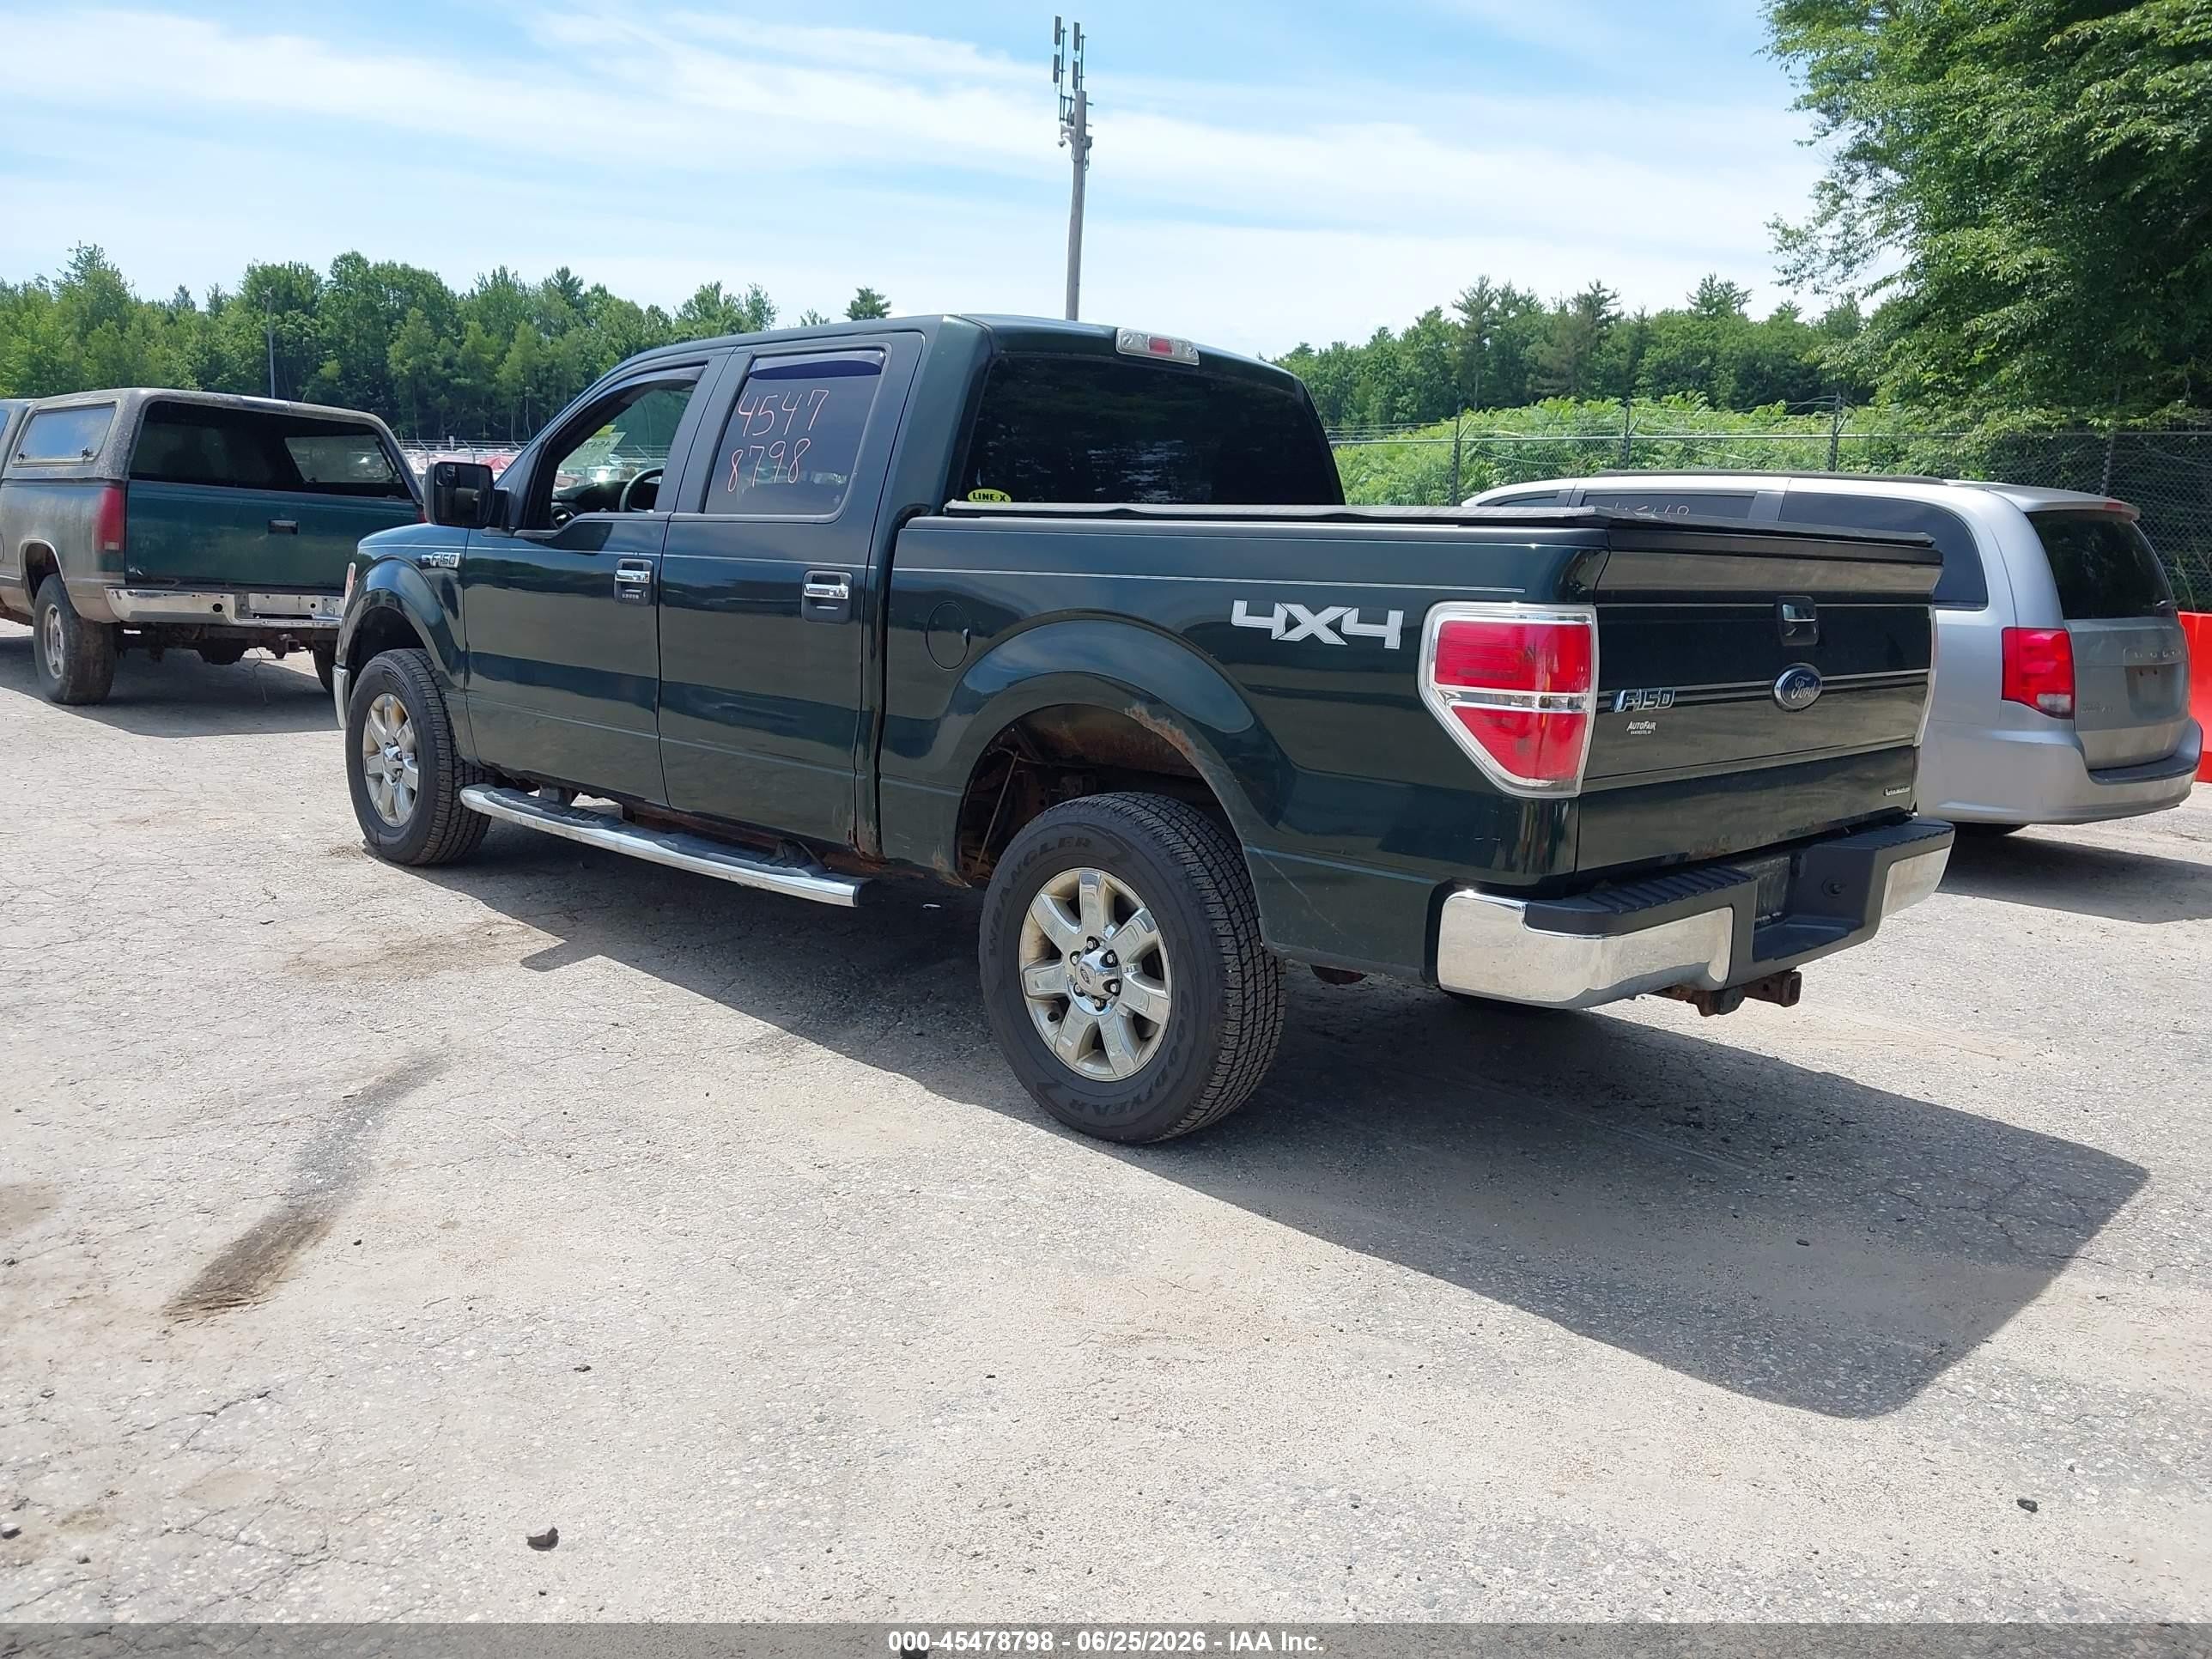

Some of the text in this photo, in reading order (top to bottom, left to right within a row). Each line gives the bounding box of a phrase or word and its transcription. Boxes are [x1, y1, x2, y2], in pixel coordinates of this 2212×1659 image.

[738, 389, 830, 437] 4547
[727, 438, 811, 493] 8798
[972, 492, 1006, 502] LINE-X
[1231, 599, 1405, 650] 4X4
[1790, 675, 1817, 700] Ford
[1067, 989, 1191, 1117] GOODYEAR
